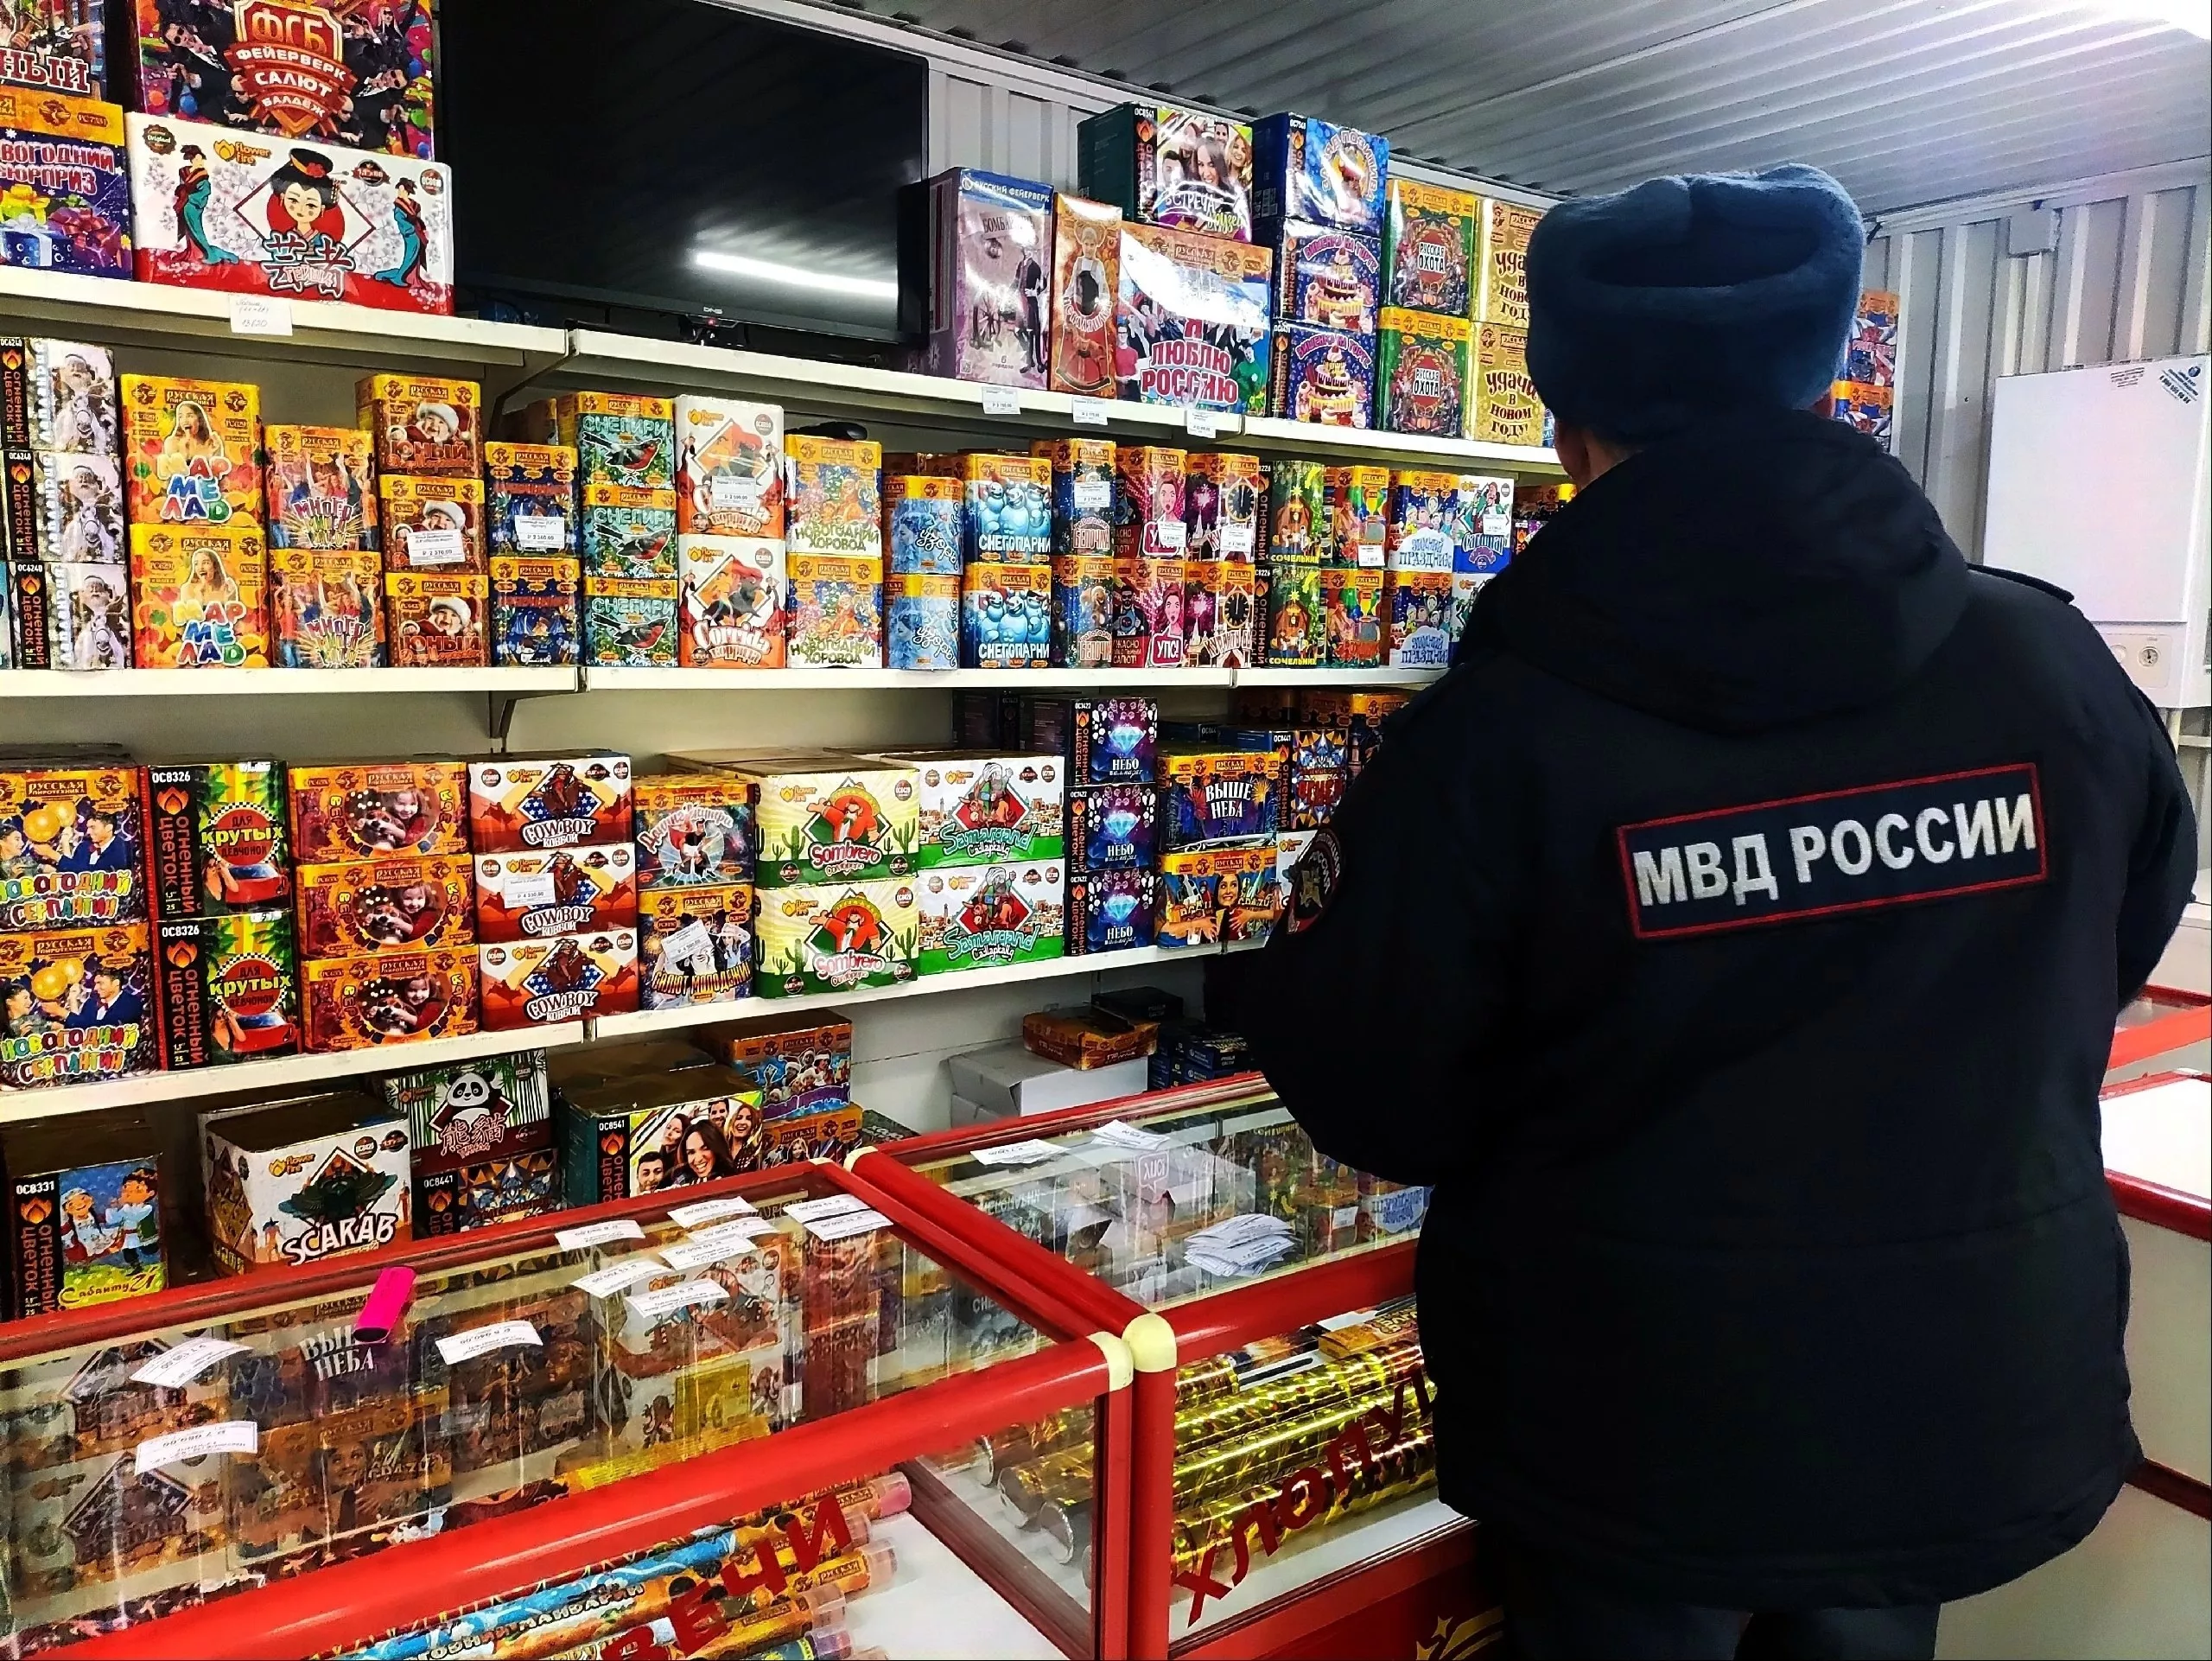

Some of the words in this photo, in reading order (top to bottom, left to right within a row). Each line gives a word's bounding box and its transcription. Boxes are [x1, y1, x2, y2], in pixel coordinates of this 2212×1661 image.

[251, 7, 327, 54] ФСБ
[236, 45, 346, 82] ФЕЙЕРВЕРК
[255, 71, 332, 98] САЛЮТ
[1416, 257, 1446, 273] ОХОТА
[1149, 341, 1232, 377] ЛЮБЛЮ
[1140, 368, 1239, 404] РОССИЮ
[1412, 380, 1440, 398] ОХОТА
[13, 371, 25, 444] ОГНЕННЫЙ
[582, 416, 668, 434] СНЕГИРИ
[168, 474, 221, 502] МЕ
[22, 484, 34, 557] ОГНЕННЫЙ
[594, 506, 677, 525] СНЕГИРИ
[796, 521, 880, 547] НОВОГОДНИЙ
[1260, 495, 1268, 561] ОГНЕННЫЙ
[809, 534, 867, 553] ХОРОВОД
[978, 533, 1052, 554] СНЕГОПАРНИ
[17, 563, 43, 572] ОС6240
[591, 596, 676, 615] СНЕГИРИ
[33, 595, 45, 666] ОГНЕННЫЙ
[183, 620, 238, 645] МЕ
[692, 620, 772, 649] Corrida
[1258, 599, 1268, 665] ОГНЕННЫЙ
[404, 633, 480, 652] ЮНЫЙ
[790, 634, 875, 658] НОВОГОДНИЙ
[978, 641, 1050, 659] СНЕГОПАРНИ
[1157, 640, 1179, 659] УПС!
[805, 649, 862, 665] ХОРОВОД
[1269, 657, 1317, 665] СОЧЕЛЬНИК
[1113, 759, 1139, 771] НЕБО
[29, 781, 85, 791] РУССКАЯ
[151, 771, 191, 784] ОС8326
[1205, 780, 1253, 803] ВЫШЕ
[1211, 799, 1243, 819] НЕБА
[232, 815, 253, 828] ДЛЯ
[521, 818, 597, 845] COWBOY
[220, 845, 268, 857] ДЕВЧОНОК
[542, 832, 579, 848] КОВБОЙ
[1108, 843, 1134, 856] НЕБО
[1633, 835, 1779, 909] МВД
[1788, 792, 2038, 884] РОССИИ
[162, 817, 175, 888] ЦВЕТОК
[810, 844, 882, 867] Sombrero
[178, 817, 203, 913] ОГНЕННЫЙ
[0, 870, 131, 902] НОВОГОДНИЙ
[10, 894, 119, 926] СЕРПАНТИН
[521, 905, 594, 933] COWBOY
[162, 925, 200, 938] ОС8326
[541, 921, 576, 937] КОВБОЙ
[1108, 926, 1134, 939] НЕБО
[35, 939, 92, 950] РУССКАЯ
[239, 965, 260, 979] ДЛЯ
[653, 971, 690, 996] САЛЮТ
[691, 961, 751, 996] МОЛОДЕЖИ!
[814, 955, 886, 980] Sombrero
[170, 970, 184, 1040] ЦВЕТОК
[228, 995, 275, 1009] ДЕВЧОНОК
[526, 990, 598, 1018] COWBOY
[546, 1005, 582, 1021] КОВБОЙ
[186, 969, 210, 1063] ОГНЕННЫЙ
[0, 1024, 139, 1060] НОВОГОДНИЙ
[18, 1050, 125, 1084] СЕРПАНТИН
[599, 1120, 625, 1131] ОС8541
[285, 1153, 316, 1168] flower
[285, 1165, 302, 1174] fire
[16, 1181, 54, 1194] ОС8331
[423, 1175, 454, 1187] ОС8441
[281, 1212, 399, 1268] SCARAB
[20, 1226, 38, 1292] ЦВЕТОК
[40, 1225, 55, 1311] ОГНЕННЫЙ
[58, 1273, 157, 1305] Сабантуй
[315, 1347, 375, 1381] НЕБА
